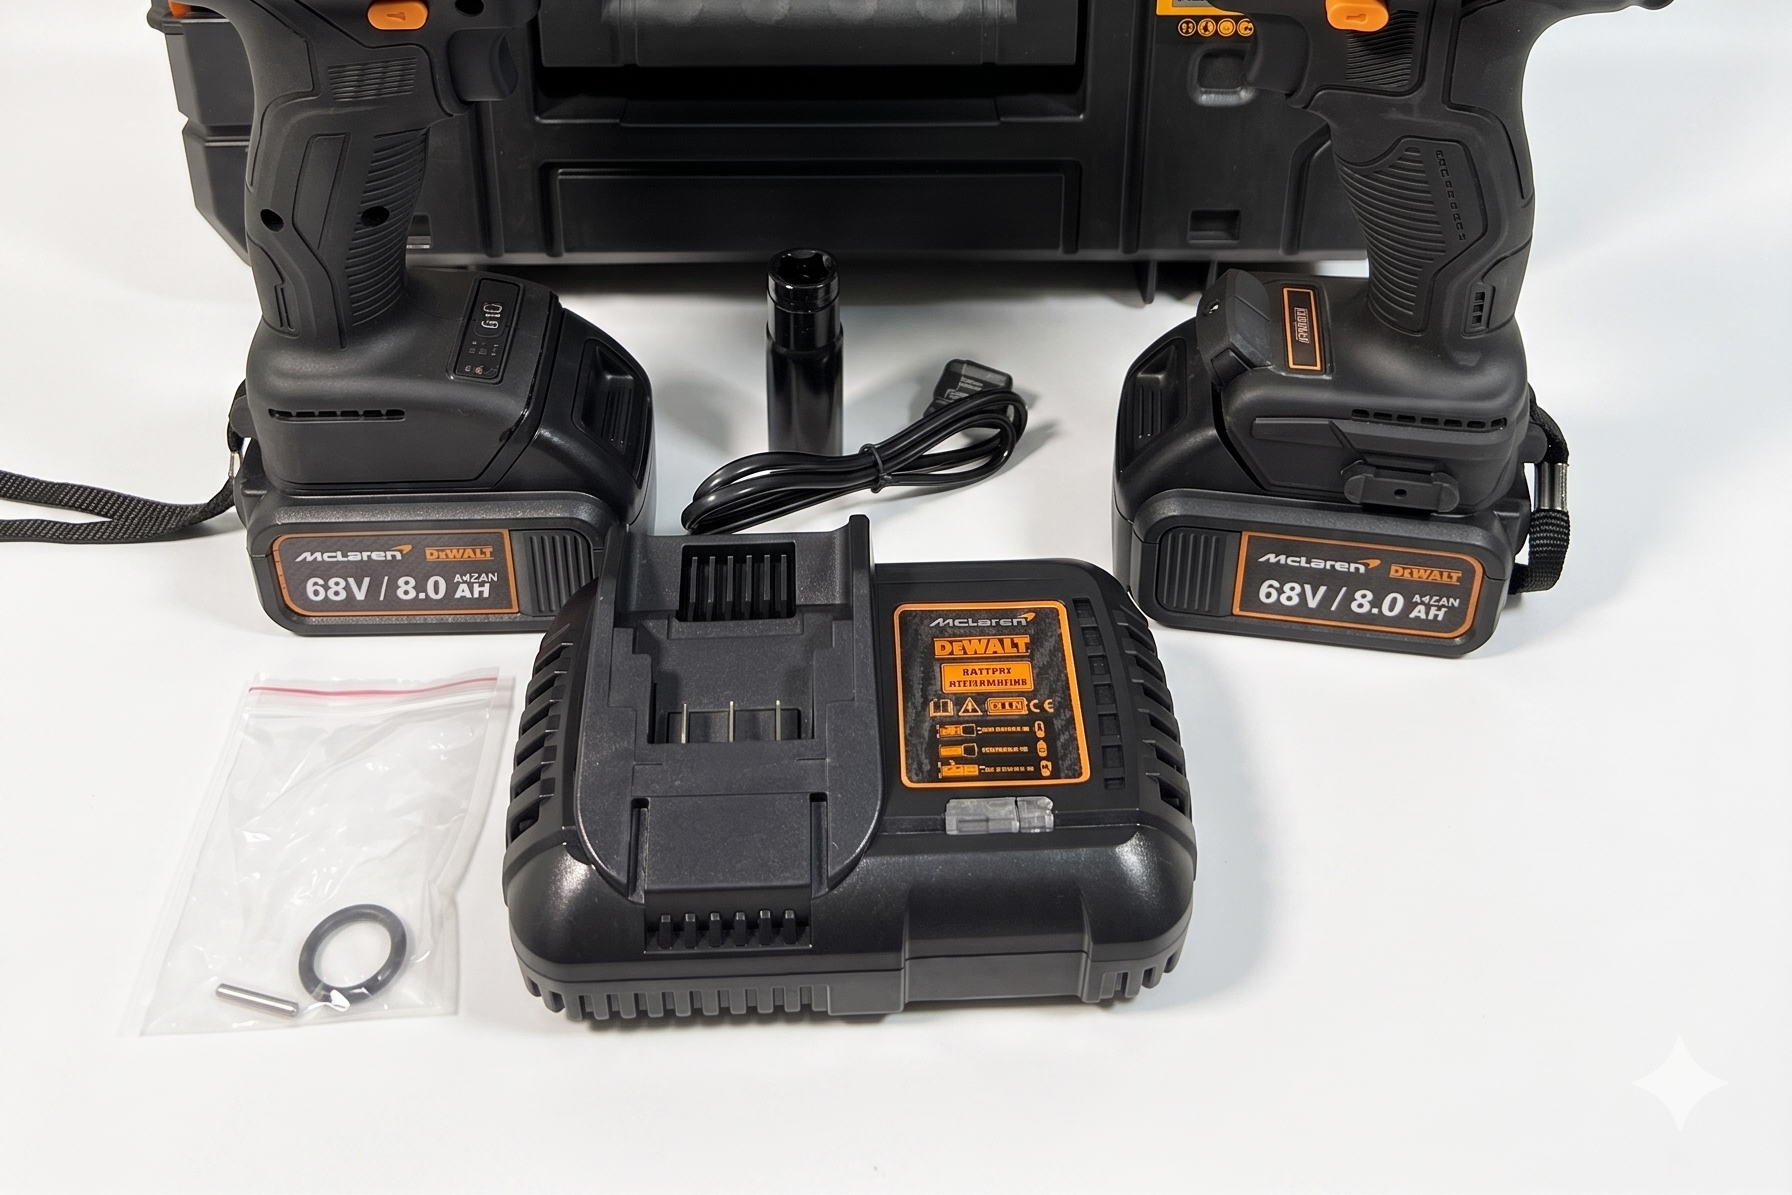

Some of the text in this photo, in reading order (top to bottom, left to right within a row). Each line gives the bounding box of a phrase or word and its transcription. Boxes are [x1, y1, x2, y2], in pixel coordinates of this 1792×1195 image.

[295, 550, 402, 562] McLaren
[1258, 553, 1366, 574] McLaren
[306, 576, 370, 602] 68V
[396, 575, 447, 601] 8.0
[454, 583, 490, 599] AH
[1258, 579, 1327, 610] 68V
[1350, 589, 1405, 617] 8.0
[1408, 604, 1448, 621] AH
[929, 617, 1027, 627] McLaren
